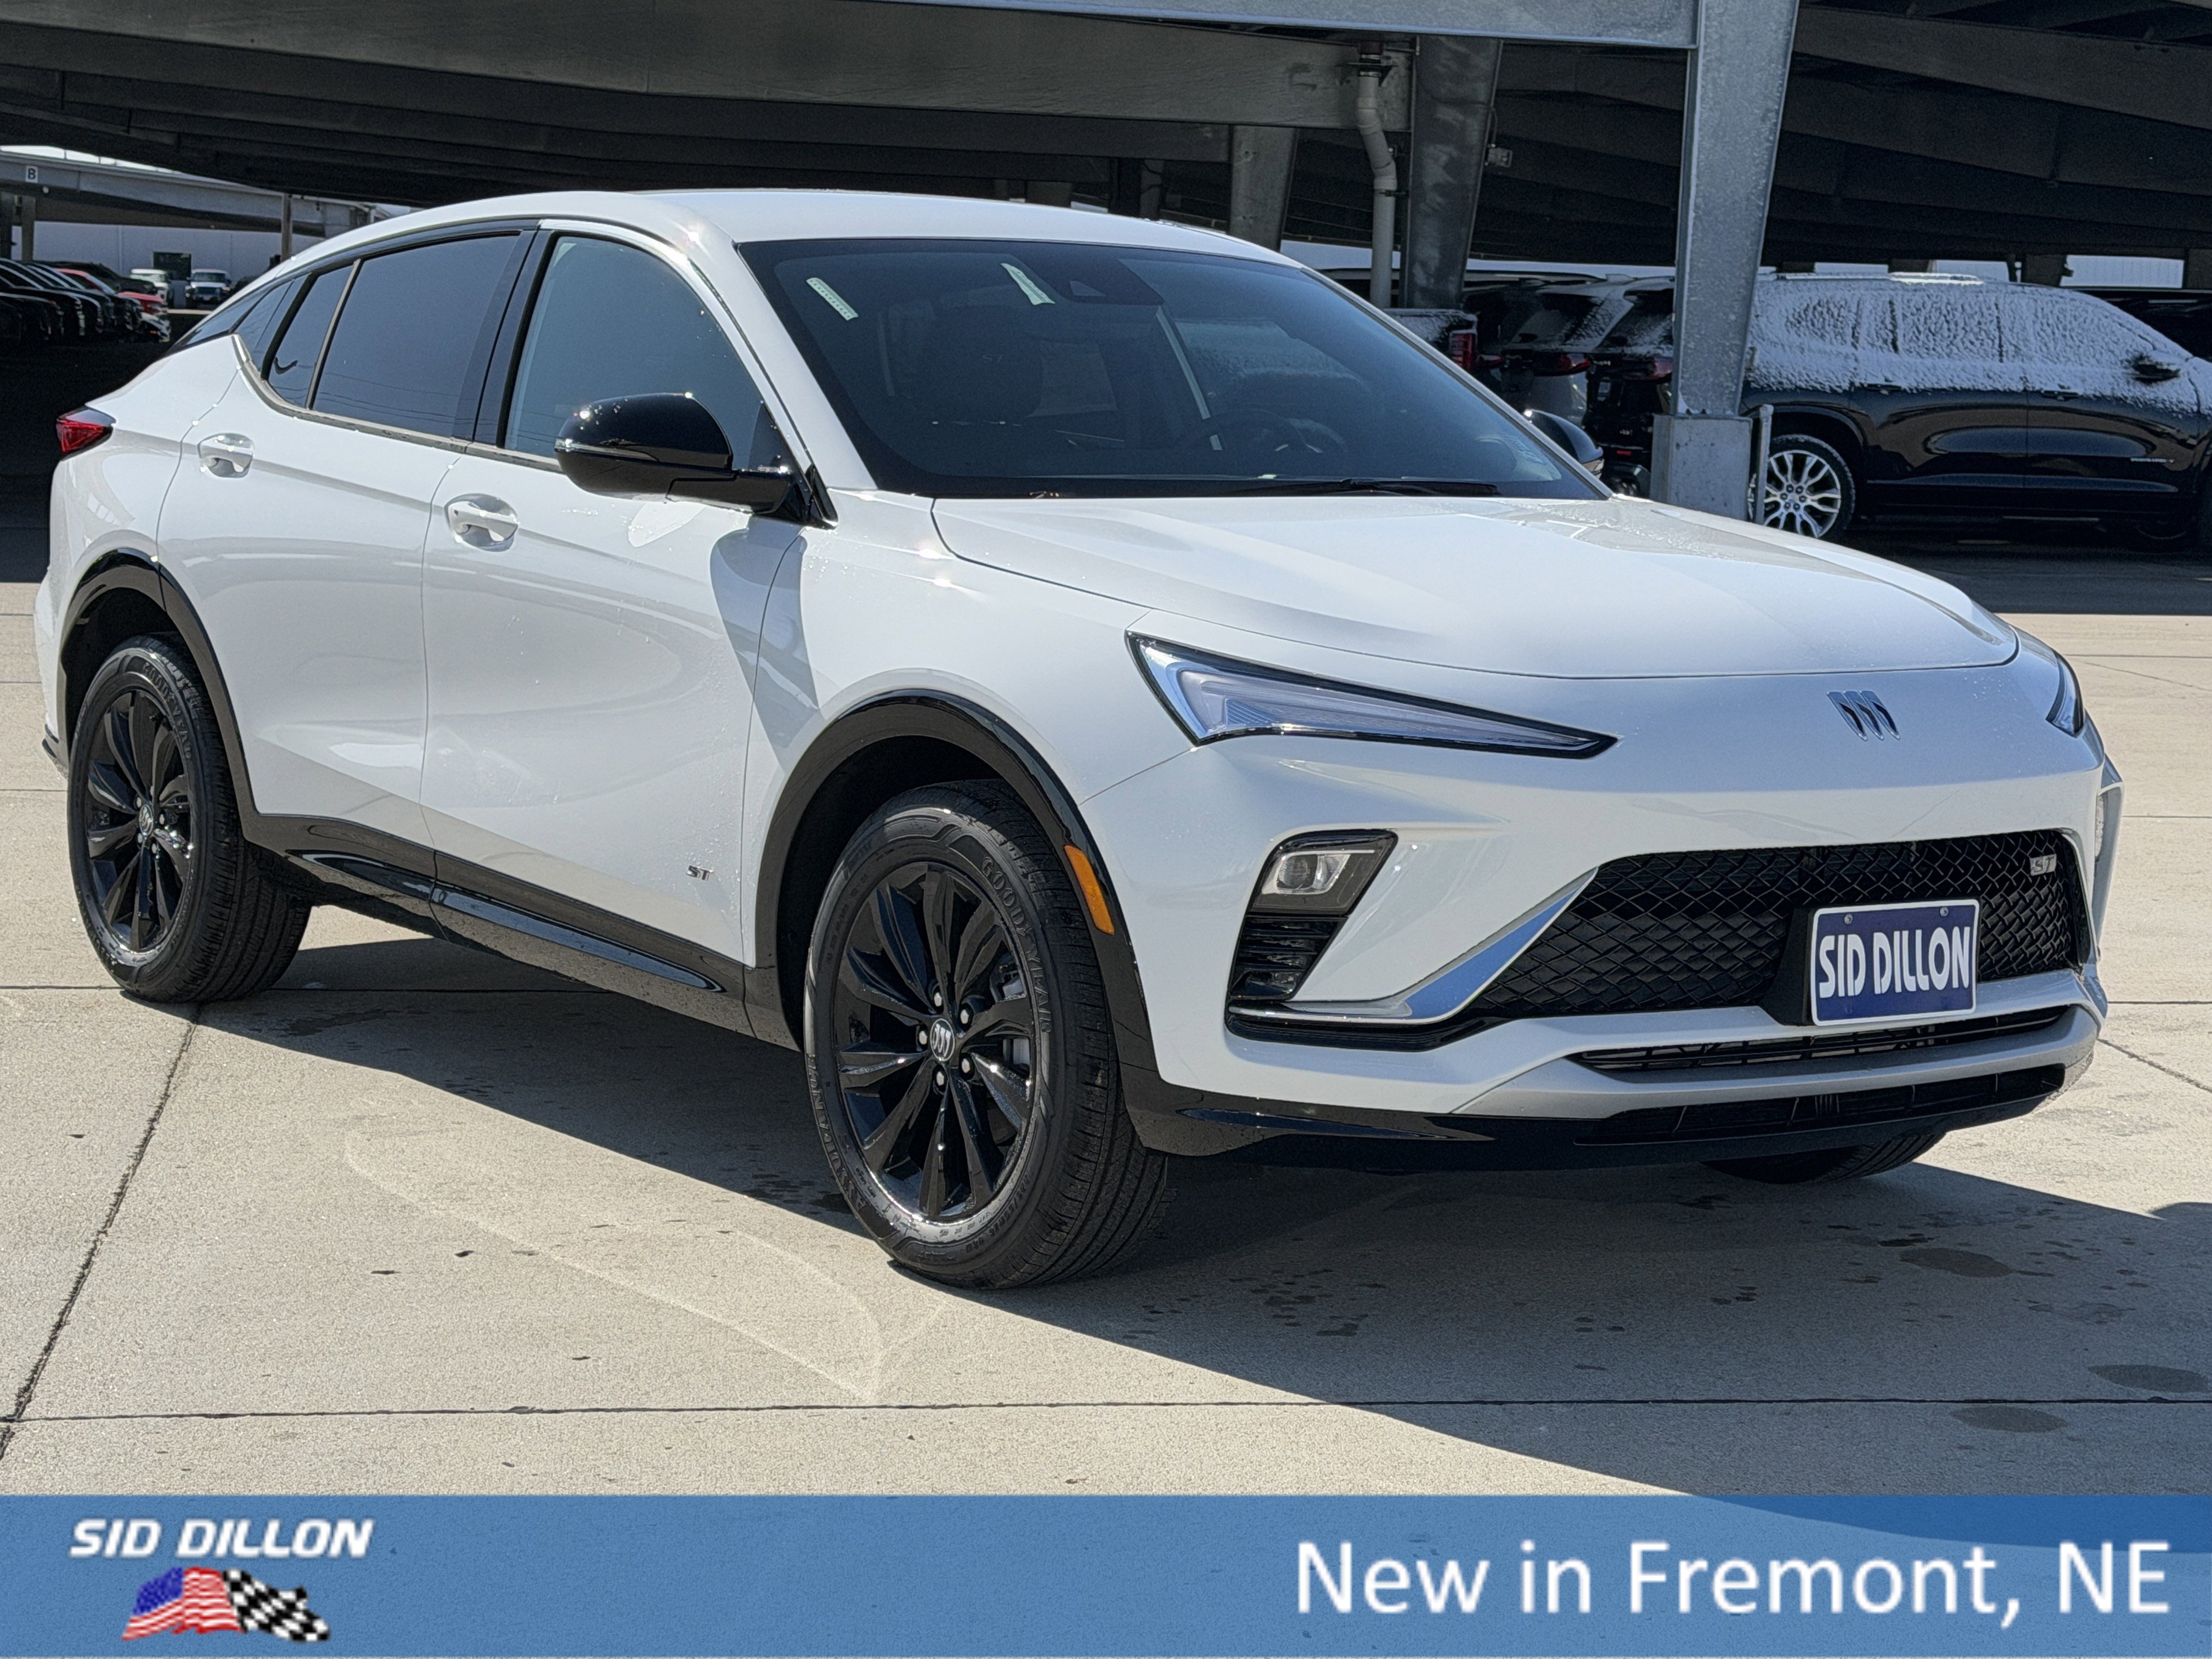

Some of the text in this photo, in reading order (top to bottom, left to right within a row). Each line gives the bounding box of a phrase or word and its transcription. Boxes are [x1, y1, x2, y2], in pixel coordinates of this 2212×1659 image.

[28, 168, 36, 180] B
[686, 865, 714, 881] ST
[2031, 855, 2056, 874] ST
[981, 855, 1052, 1034] GOODYEAR
[1819, 926, 1970, 998] SID DILLON
